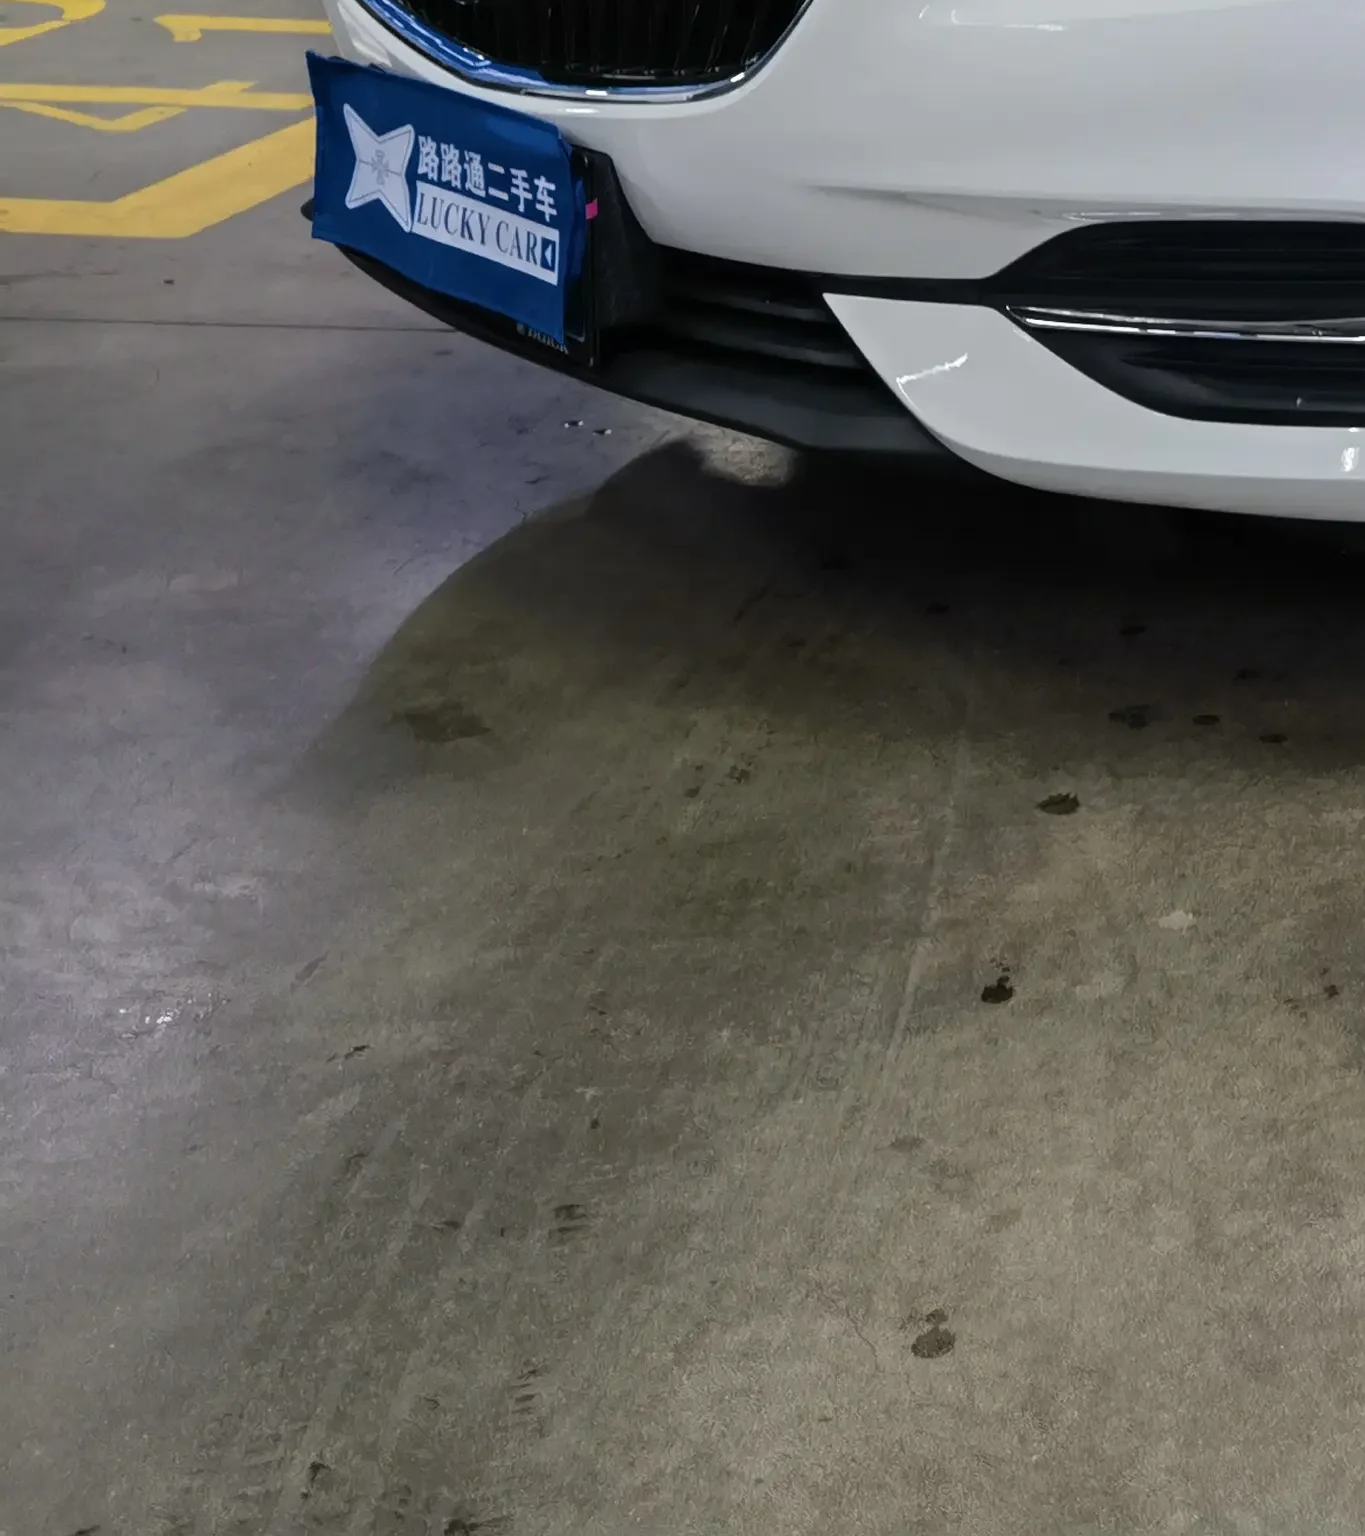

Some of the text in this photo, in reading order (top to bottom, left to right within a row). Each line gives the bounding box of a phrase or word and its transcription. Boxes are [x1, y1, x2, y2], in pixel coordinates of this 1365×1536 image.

[417, 135, 558, 222] 路路通二手车
[416, 192, 538, 267] LUCKY CAR
